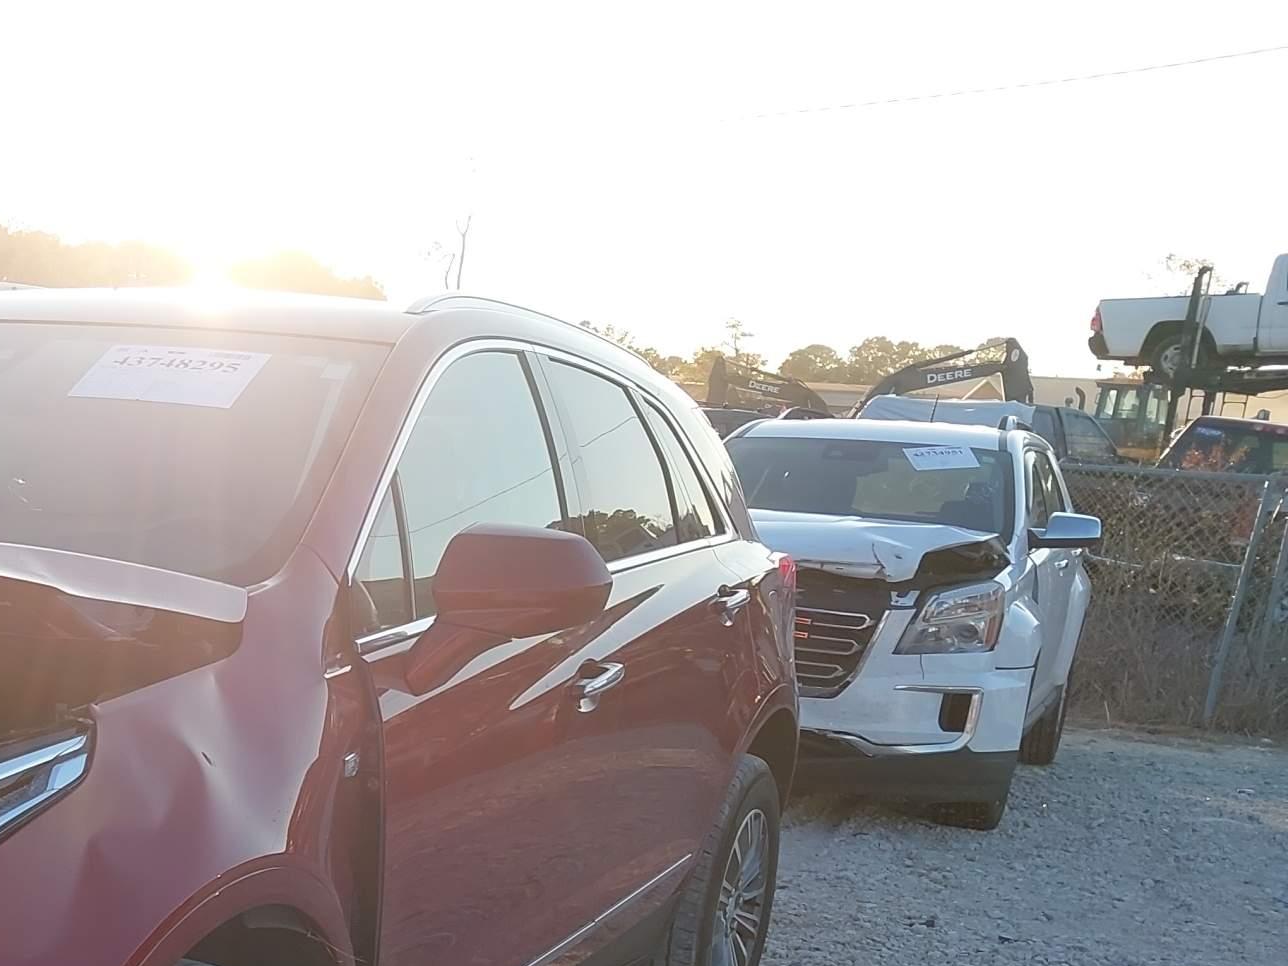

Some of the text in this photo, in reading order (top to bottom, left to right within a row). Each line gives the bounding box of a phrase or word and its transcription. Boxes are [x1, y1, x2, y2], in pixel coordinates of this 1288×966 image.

[113, 355, 241, 373] 43748295
[927, 368, 972, 384] DEERE
[749, 380, 781, 394] DEERE
